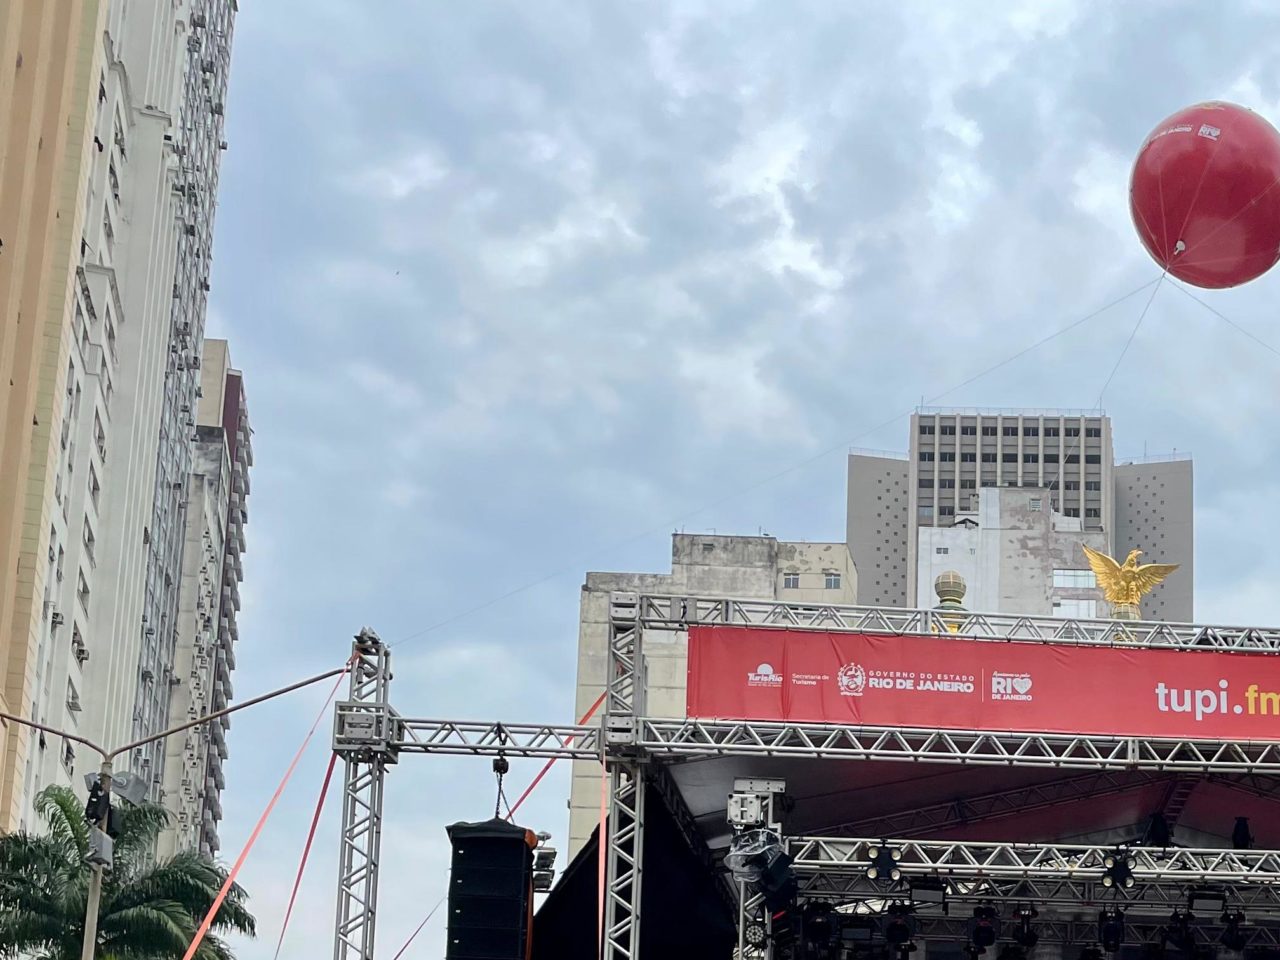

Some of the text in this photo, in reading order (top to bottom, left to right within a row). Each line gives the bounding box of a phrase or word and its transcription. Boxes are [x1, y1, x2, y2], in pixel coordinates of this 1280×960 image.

[868, 670, 916, 679] GOVERNO
[937, 673, 975, 682] ESTADO
[868, 677, 975, 693] RIO DE JANEIRO
